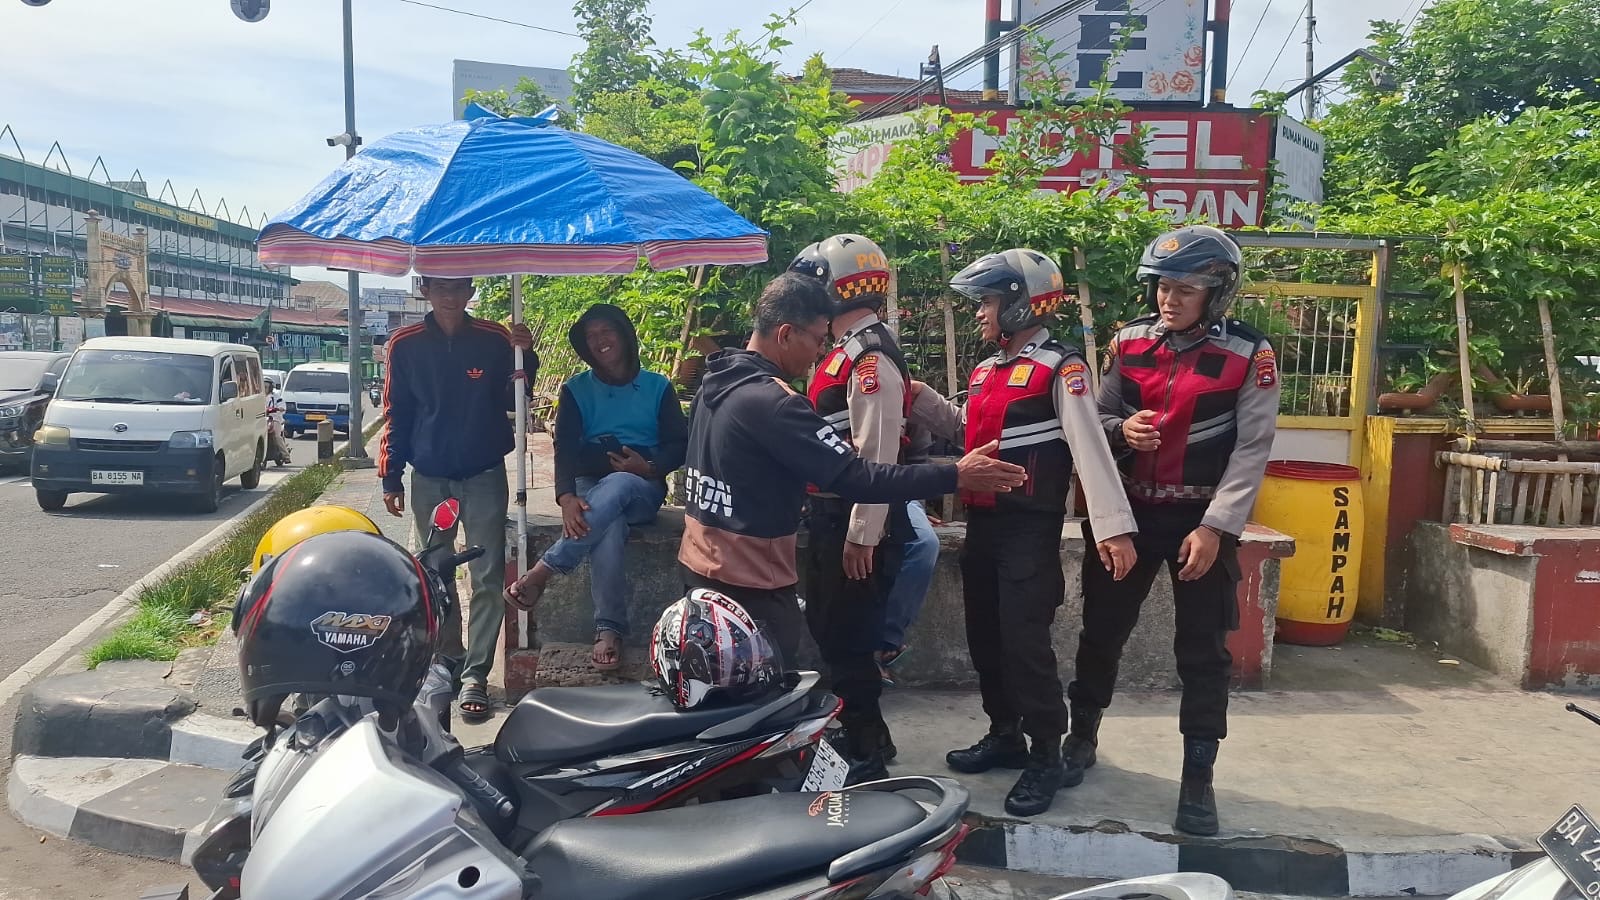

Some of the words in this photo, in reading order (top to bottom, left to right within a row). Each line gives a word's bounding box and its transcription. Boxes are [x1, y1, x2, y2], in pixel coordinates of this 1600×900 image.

[1075, 0, 1148, 88] EL
[972, 118, 1242, 169] HOTEL
[1302, 135, 1319, 154] MAKAN
[92, 472, 103, 480] BA
[131, 472, 142, 481] NA
[1325, 487, 1351, 619] SAMPAH
[325, 631, 368, 646] YAMAHA
[1556, 811, 1587, 847] BA
